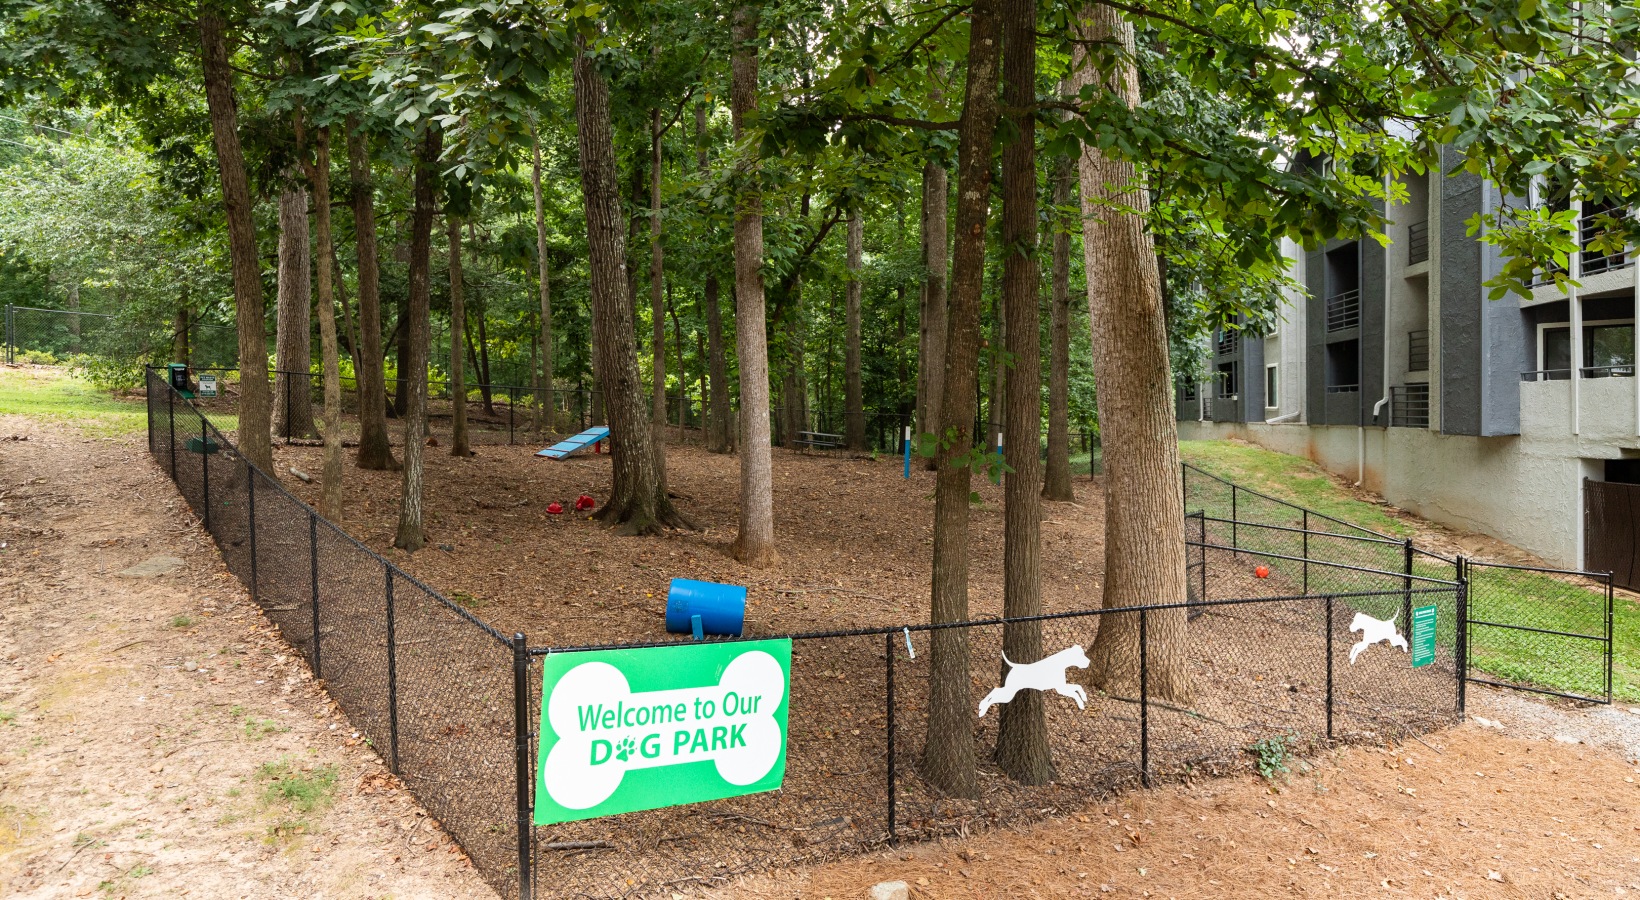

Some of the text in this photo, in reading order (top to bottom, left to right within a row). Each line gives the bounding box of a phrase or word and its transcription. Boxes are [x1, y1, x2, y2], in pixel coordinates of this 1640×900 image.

[577, 691, 762, 732] Welcome to Our
[673, 723, 748, 756] PARK
